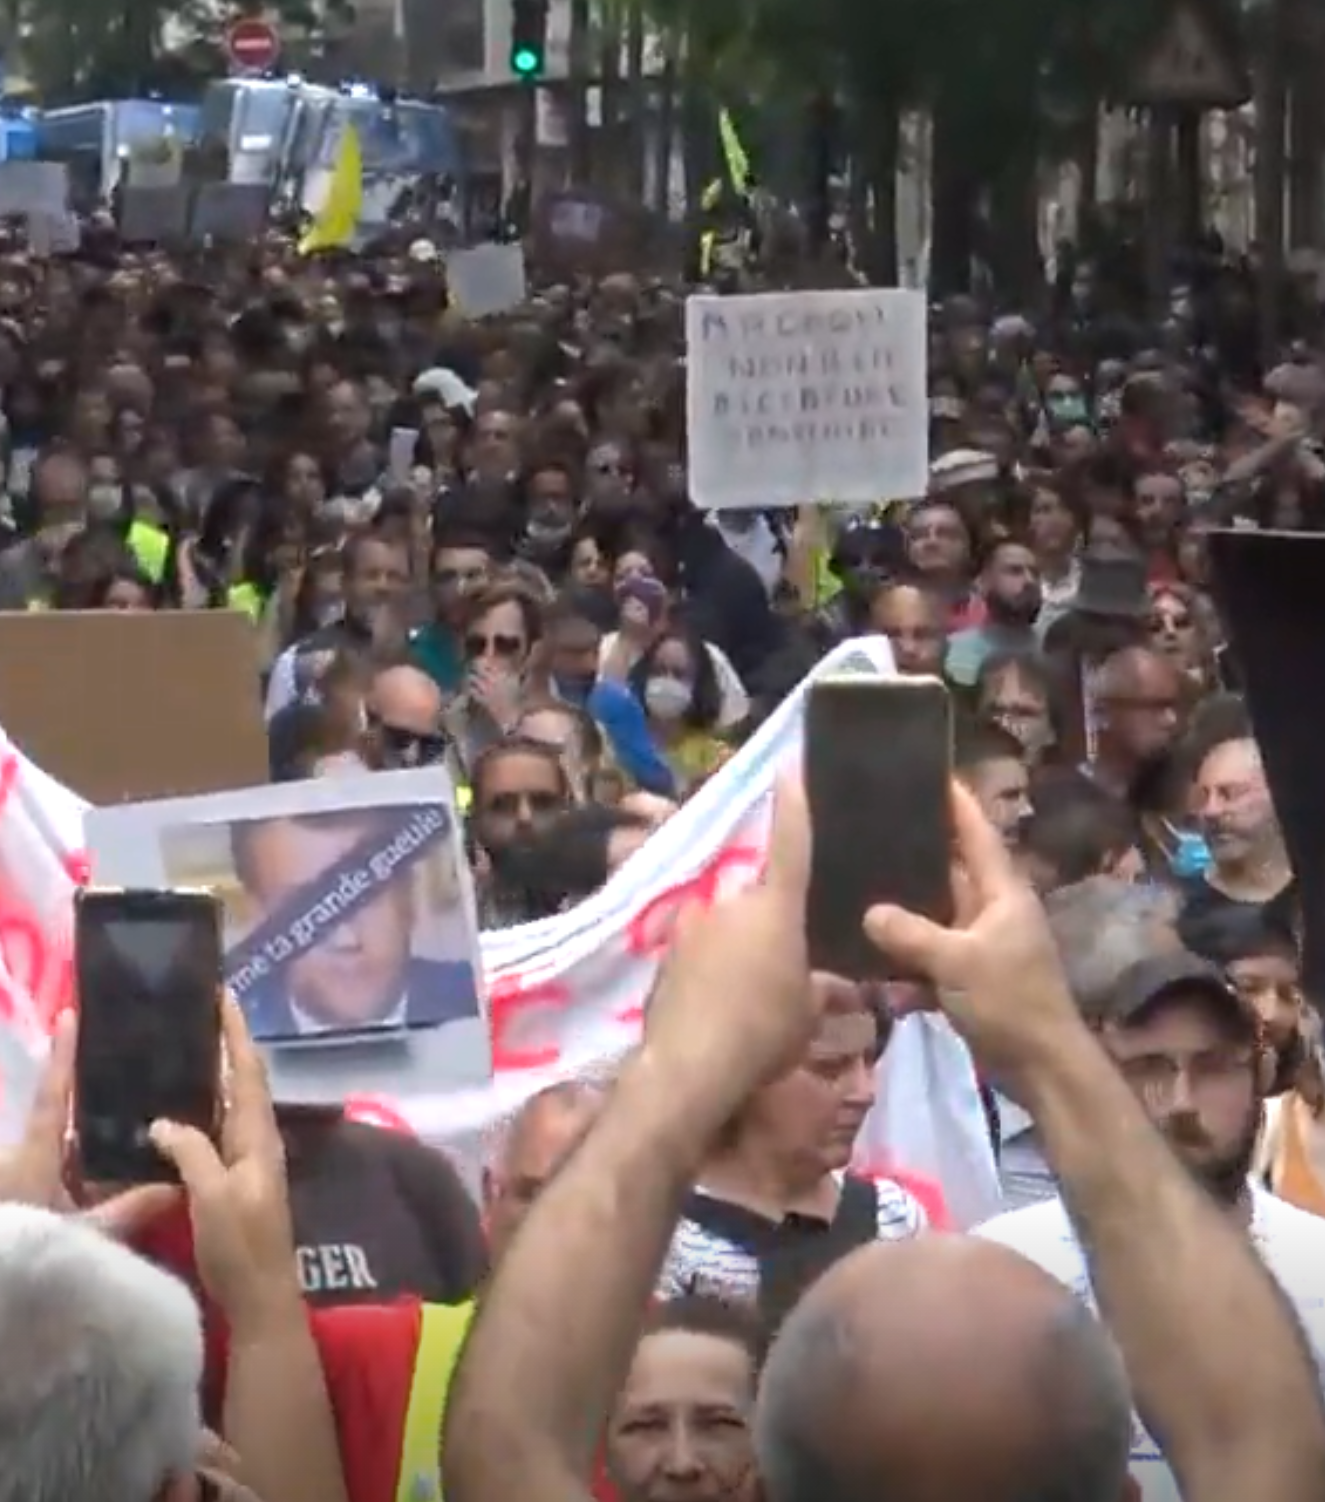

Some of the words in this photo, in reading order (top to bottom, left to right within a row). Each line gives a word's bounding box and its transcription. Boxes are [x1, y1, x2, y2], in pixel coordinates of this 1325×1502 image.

[264, 934, 293, 961] ta
[290, 870, 371, 947] grande
[369, 808, 443, 881] gueule
